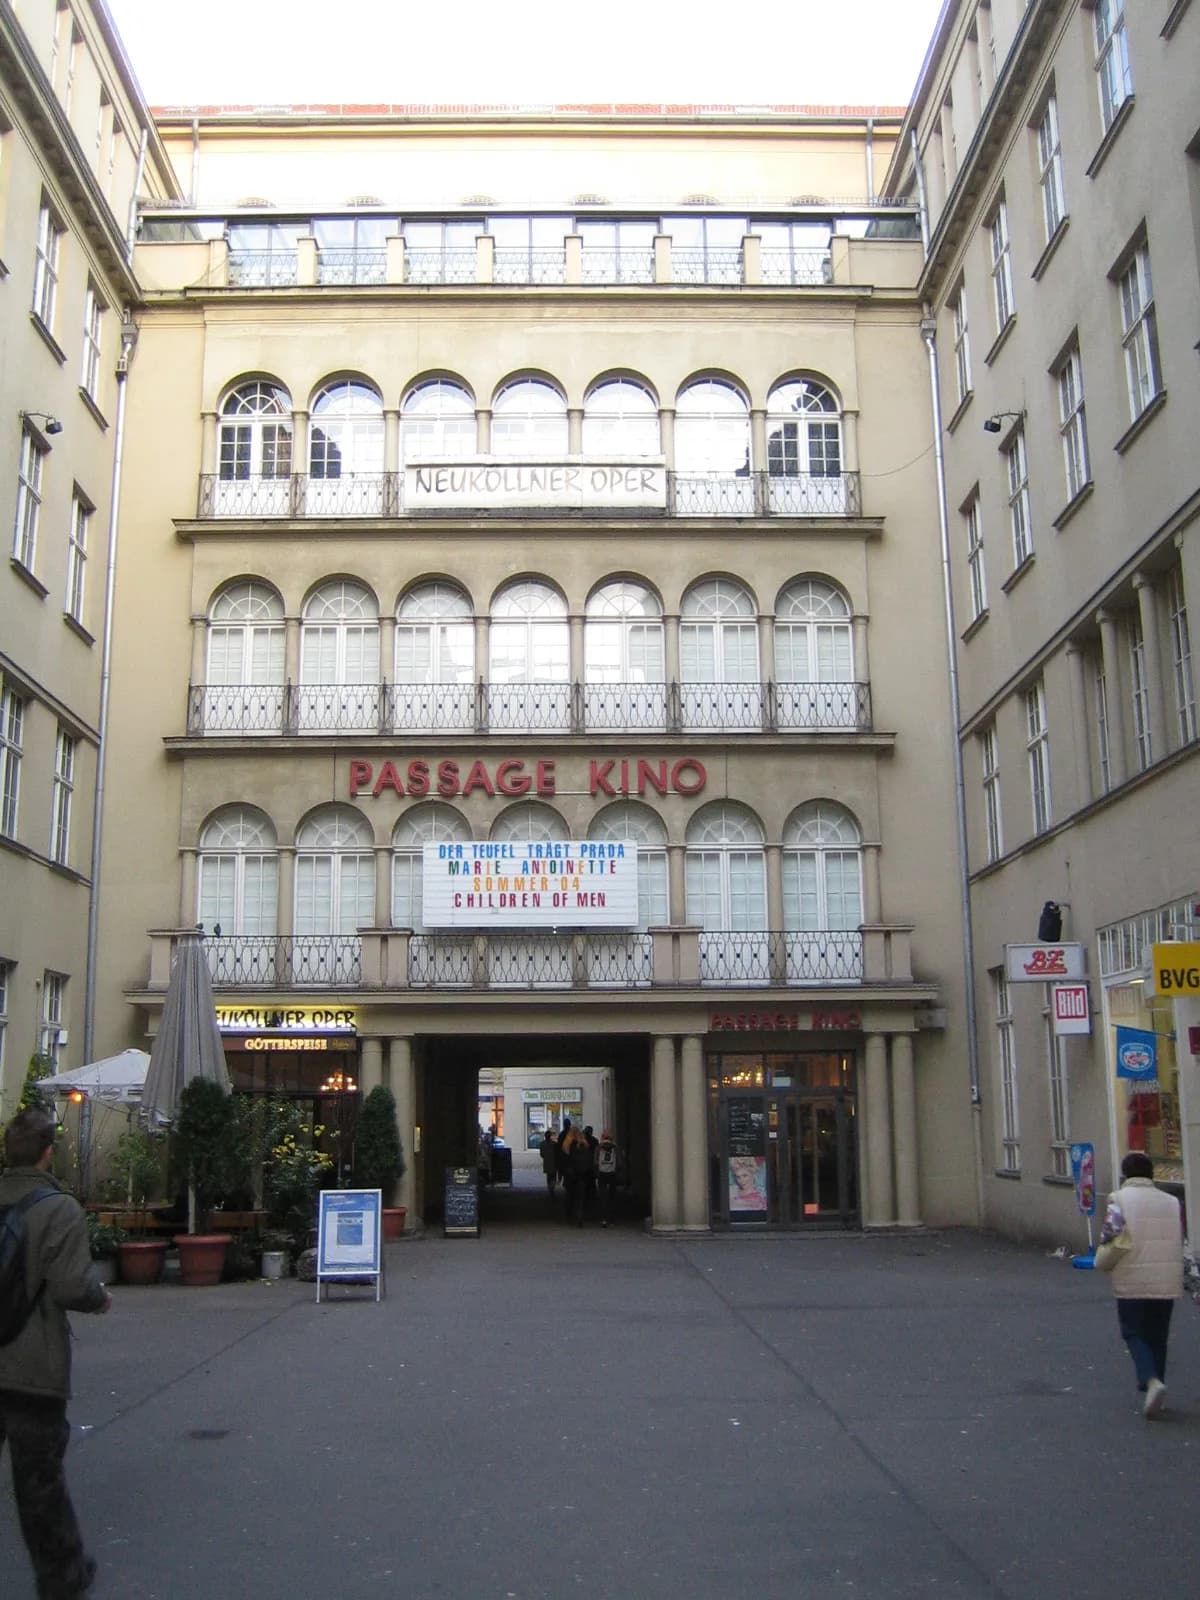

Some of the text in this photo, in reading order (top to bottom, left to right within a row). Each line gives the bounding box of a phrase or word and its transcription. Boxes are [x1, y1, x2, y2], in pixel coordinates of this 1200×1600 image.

[590, 469, 658, 493] OPER
[351, 759, 707, 797] PASSAGE KINO
[439, 842, 625, 859] DER TEUFEL TRÄGT PRADA
[448, 860, 616, 875] MARIE ANTOINETTE
[473, 877, 548, 892] SOMMER
[454, 893, 606, 908] CHILDREN OF MEN
[1160, 968, 1200, 989] BVG
[1058, 990, 1085, 1017] Bild
[312, 1010, 357, 1028] OPER
[244, 1037, 328, 1050] GÖTTERSPEISE
